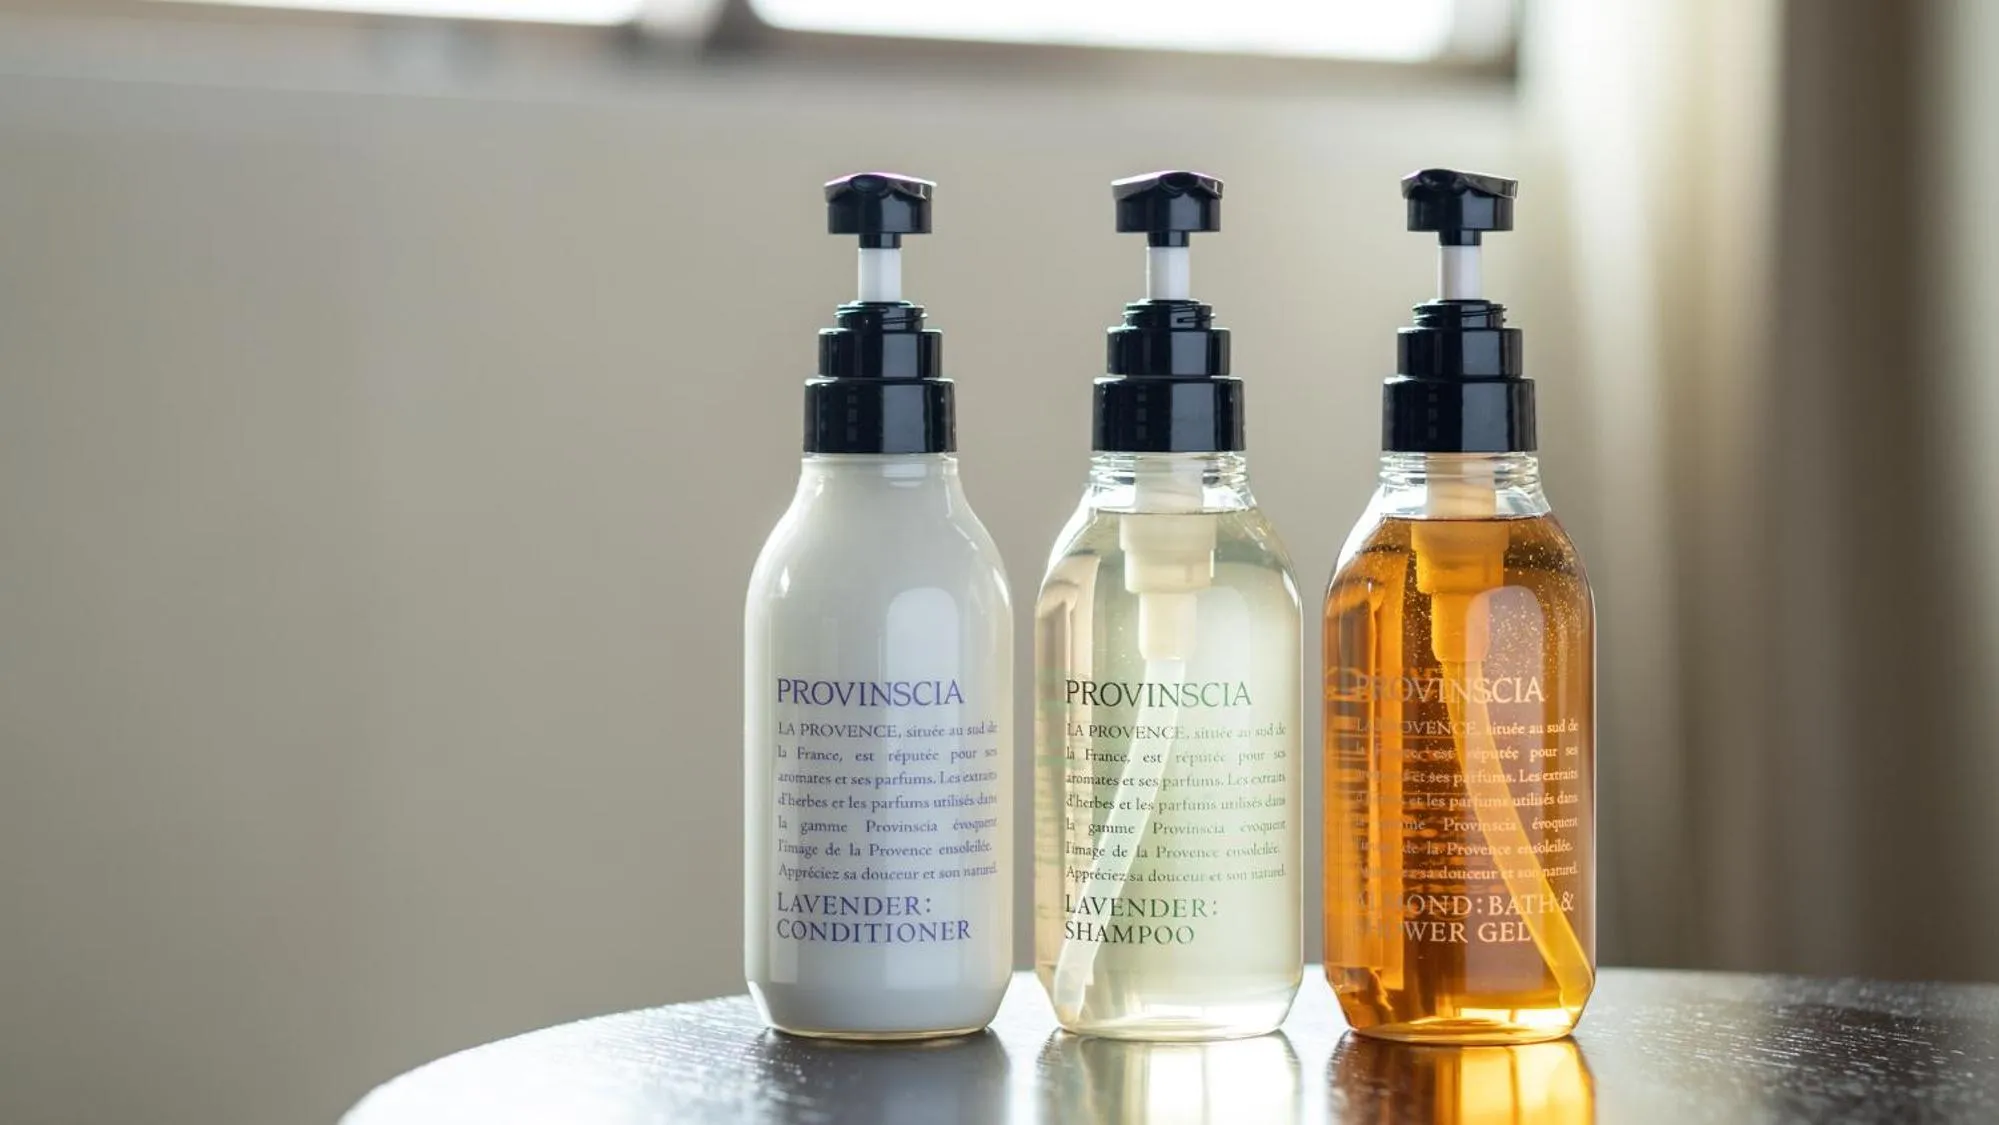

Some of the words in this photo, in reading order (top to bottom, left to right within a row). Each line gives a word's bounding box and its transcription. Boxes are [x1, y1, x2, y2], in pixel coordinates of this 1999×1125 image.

[777, 679, 964, 706] PROVINSCIA
[1066, 680, 1252, 707] PROVINSCIA
[778, 722, 795, 736] LA
[801, 724, 902, 739] PROVENCE,
[906, 723, 945, 738] située
[949, 725, 963, 736] au
[967, 721, 984, 735] sud
[1067, 724, 1083, 737] LA
[1089, 725, 1189, 739] PROVENCE,
[1530, 724, 1544, 735] au
[1547, 719, 1566, 732] sud
[1568, 718, 1578, 732] de
[778, 746, 787, 758] la
[798, 746, 843, 762] France,
[855, 750, 874, 761] est
[888, 748, 939, 765] réputée
[951, 750, 976, 764] pour
[1067, 747, 1075, 759] la
[1085, 748, 1130, 763] France,
[1143, 753, 1161, 763] est
[1239, 750, 1265, 765] pour
[1530, 747, 1556, 762] pour
[1566, 745, 1578, 756] ses
[778, 772, 831, 784] aromates
[835, 773, 847, 784] et
[850, 775, 871, 785] ses
[875, 773, 936, 789] parfums.
[940, 772, 961, 784] Les
[1067, 773, 1118, 786] aromates
[1122, 776, 1134, 786] et
[1138, 777, 1158, 787] ses
[1163, 775, 1224, 790] parfums.
[1228, 773, 1248, 786] Les
[1520, 769, 1541, 782] Les
[1543, 769, 1578, 781] extraits
[832, 798, 845, 809] et
[849, 796, 867, 809] les
[872, 795, 930, 813] parfums
[933, 794, 974, 809] utilisés
[1119, 799, 1131, 810] et
[1137, 798, 1154, 810] les
[1159, 797, 1216, 814] parfums
[1427, 796, 1445, 806] les
[1513, 792, 1554, 806] utilisés
[1557, 791, 1578, 804] dans
[778, 816, 787, 828] la
[801, 821, 848, 835] gamme
[866, 820, 937, 833] Provinscia
[1067, 818, 1075, 830] la
[1088, 823, 1135, 836] gamme
[1153, 822, 1225, 834] Provinscia
[1444, 818, 1516, 831] Provinscia
[1532, 816, 1578, 832] évoquent
[826, 843, 841, 856] de
[850, 843, 861, 857] la
[869, 844, 932, 856] Provence
[1112, 845, 1128, 857] de
[1137, 845, 1148, 858] la
[1156, 845, 1220, 858] Provence
[1427, 841, 1438, 855] la
[1447, 842, 1510, 855] Provence
[779, 863, 839, 880] Appréciez
[843, 870, 857, 880] sa
[862, 867, 919, 880] douceur
[923, 868, 935, 880] et
[939, 868, 960, 878] son
[1066, 864, 1126, 881] Appréciez
[1130, 870, 1143, 881] sa
[1148, 868, 1204, 882] douceur
[1209, 870, 1221, 881] et
[1227, 871, 1247, 880] son
[1438, 865, 1497, 880] douceur
[778, 892, 931, 915] LAVENDER:
[1065, 894, 1217, 917] LAVENDER:
[1488, 894, 1553, 915] BATH
[1561, 892, 1574, 912] &
[777, 919, 971, 943] CONDITIONER
[1065, 921, 1194, 944] SHAMPOO
[1478, 922, 1531, 943] GEL
